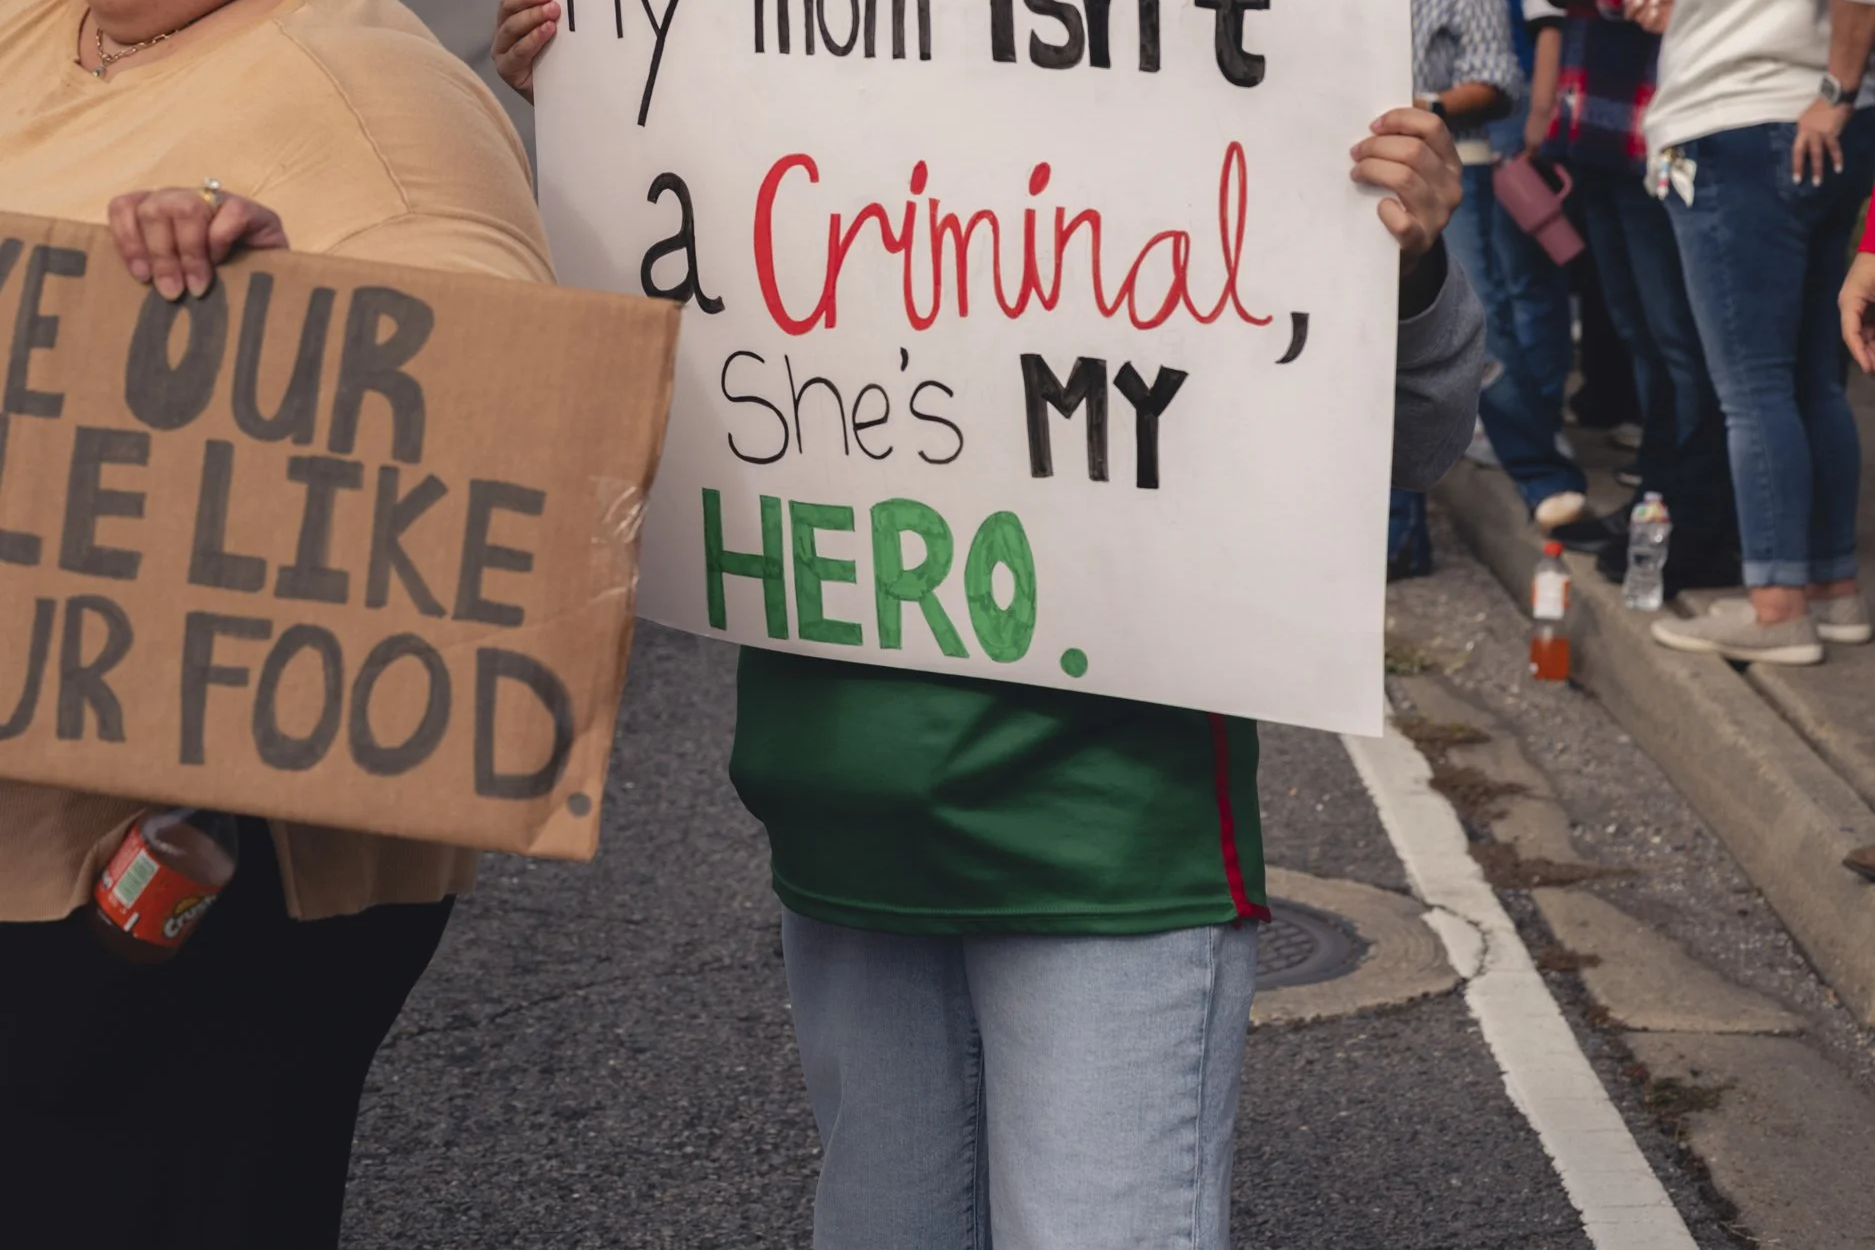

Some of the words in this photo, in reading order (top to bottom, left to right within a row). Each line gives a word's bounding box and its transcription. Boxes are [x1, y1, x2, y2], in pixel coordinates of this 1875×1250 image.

[640, 172, 725, 314] a
[754, 141, 1309, 364] Criminal,
[125, 271, 434, 464] OUR
[721, 347, 963, 465] She's
[1020, 353, 1188, 490] MY
[188, 439, 546, 627] LIKE
[702, 488, 1089, 678] HERO.
[180, 610, 592, 818] FOOD.
